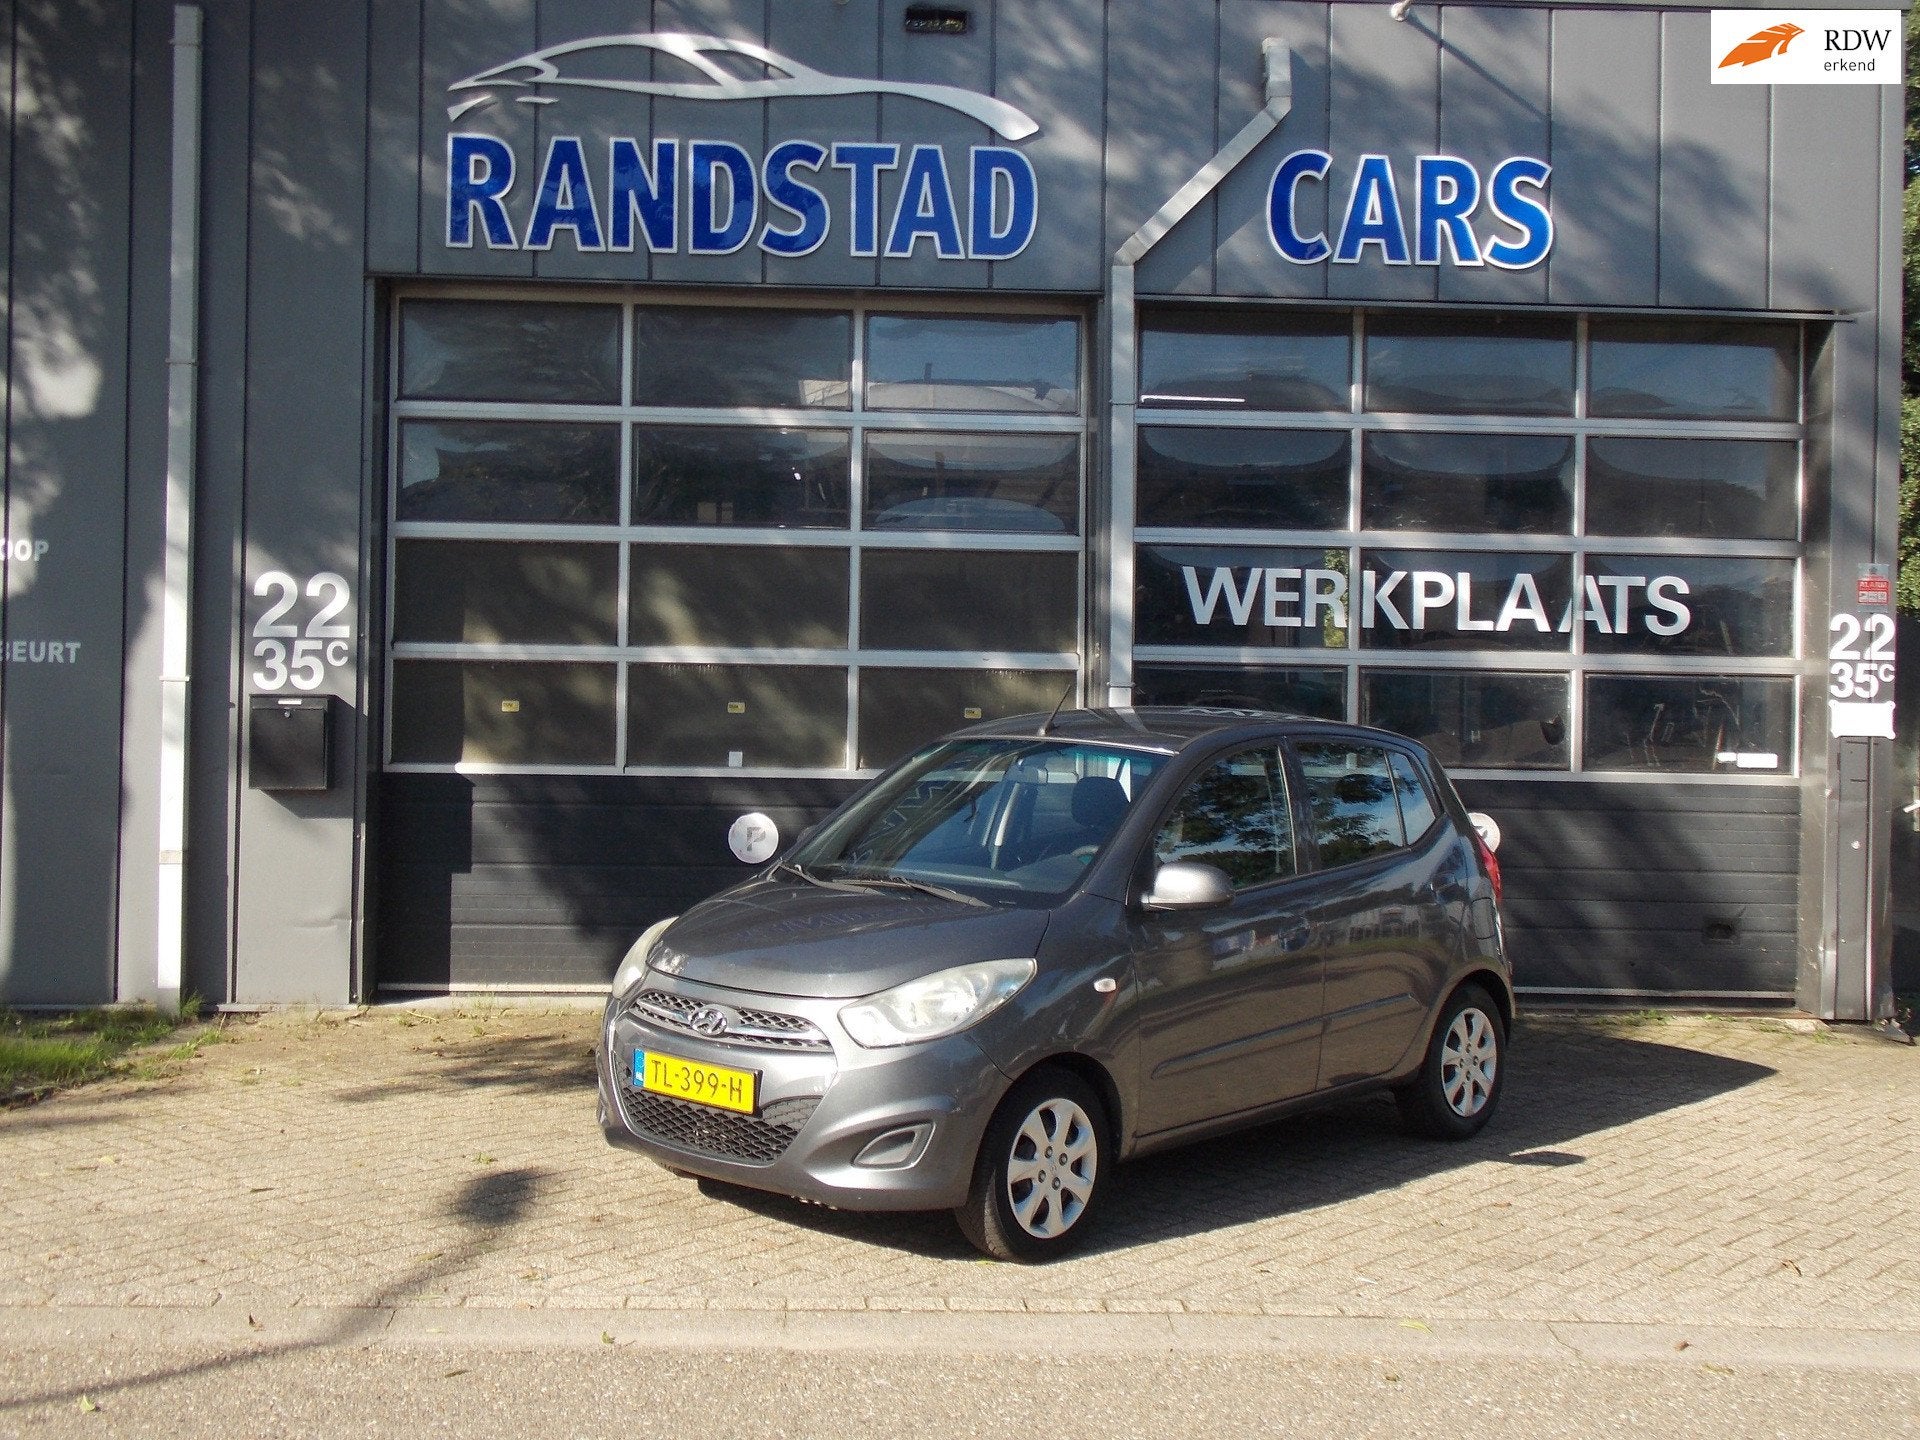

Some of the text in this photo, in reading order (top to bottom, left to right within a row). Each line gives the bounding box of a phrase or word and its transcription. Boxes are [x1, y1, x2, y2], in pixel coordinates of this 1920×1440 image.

[446, 132, 1554, 270] RANDSTAD CARS
[252, 571, 350, 638] 22
[1182, 566, 1692, 636] WERKPLAATS
[1829, 613, 1896, 660] 22
[651, 1059, 742, 1104] TL-399-H
